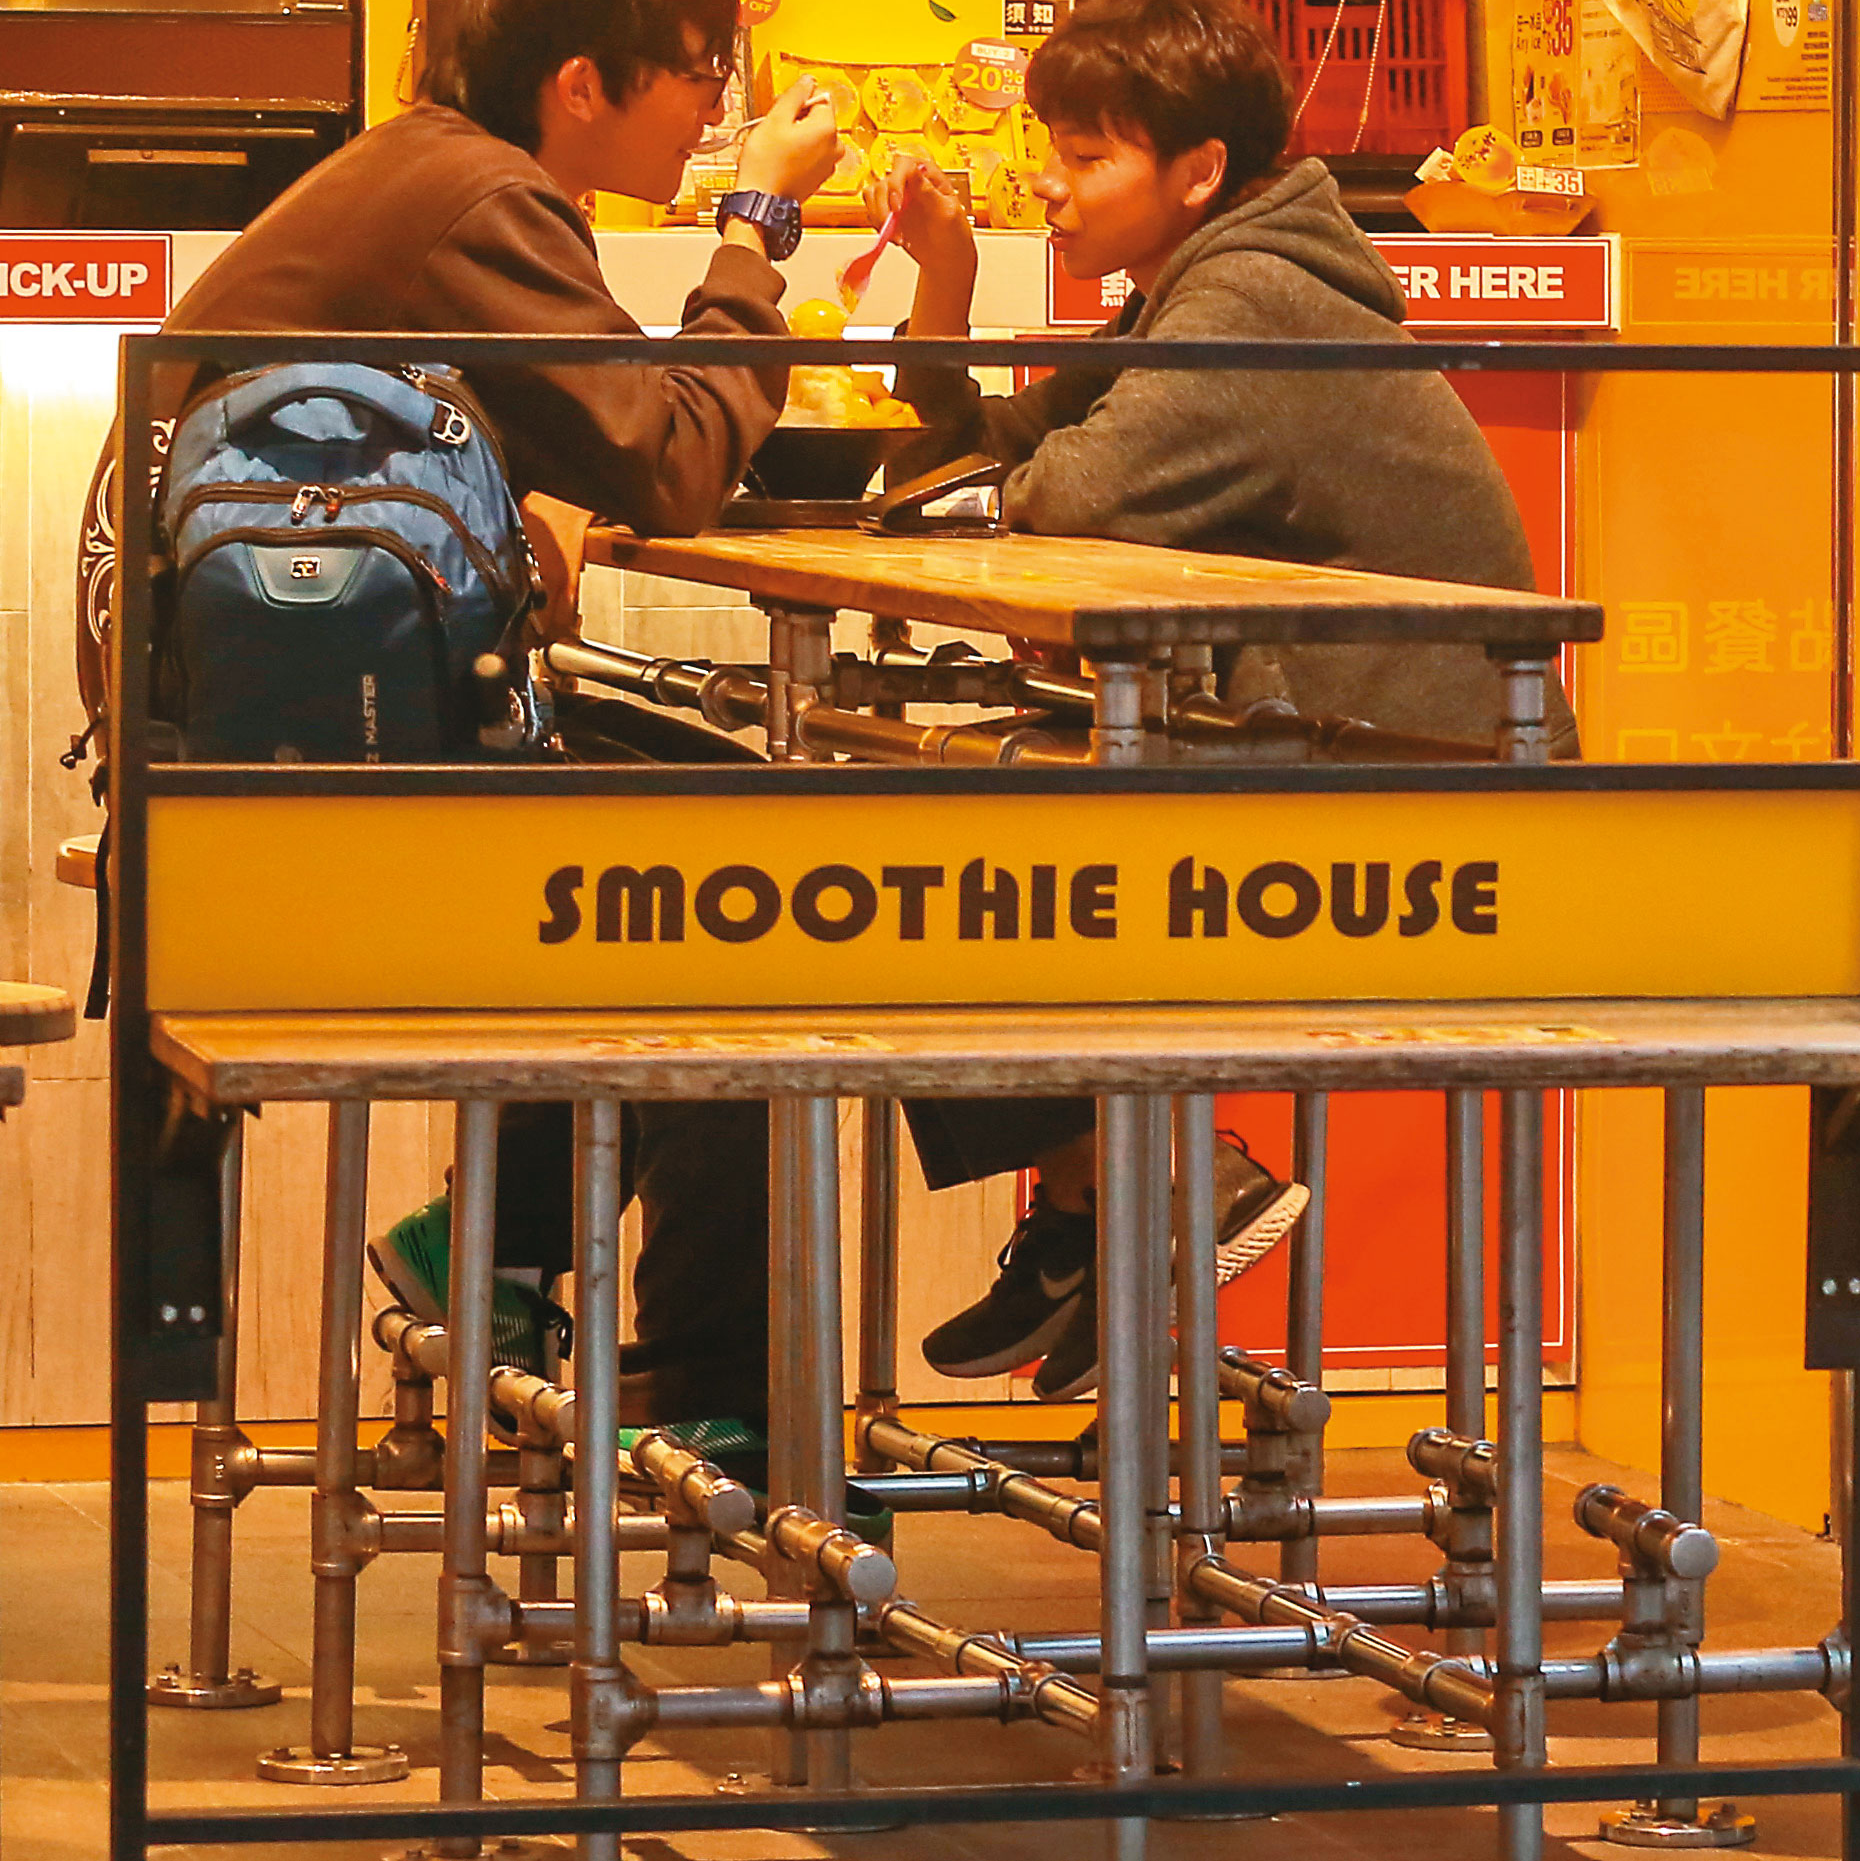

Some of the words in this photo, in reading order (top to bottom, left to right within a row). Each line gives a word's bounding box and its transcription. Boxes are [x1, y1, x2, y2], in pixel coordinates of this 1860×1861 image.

[750, 1, 772, 14] OFF
[960, 63, 1025, 92] 20%
[1450, 266, 1564, 299] HERE
[539, 855, 1119, 943] SMOOTHIE
[1168, 855, 1499, 939] HOUSE
